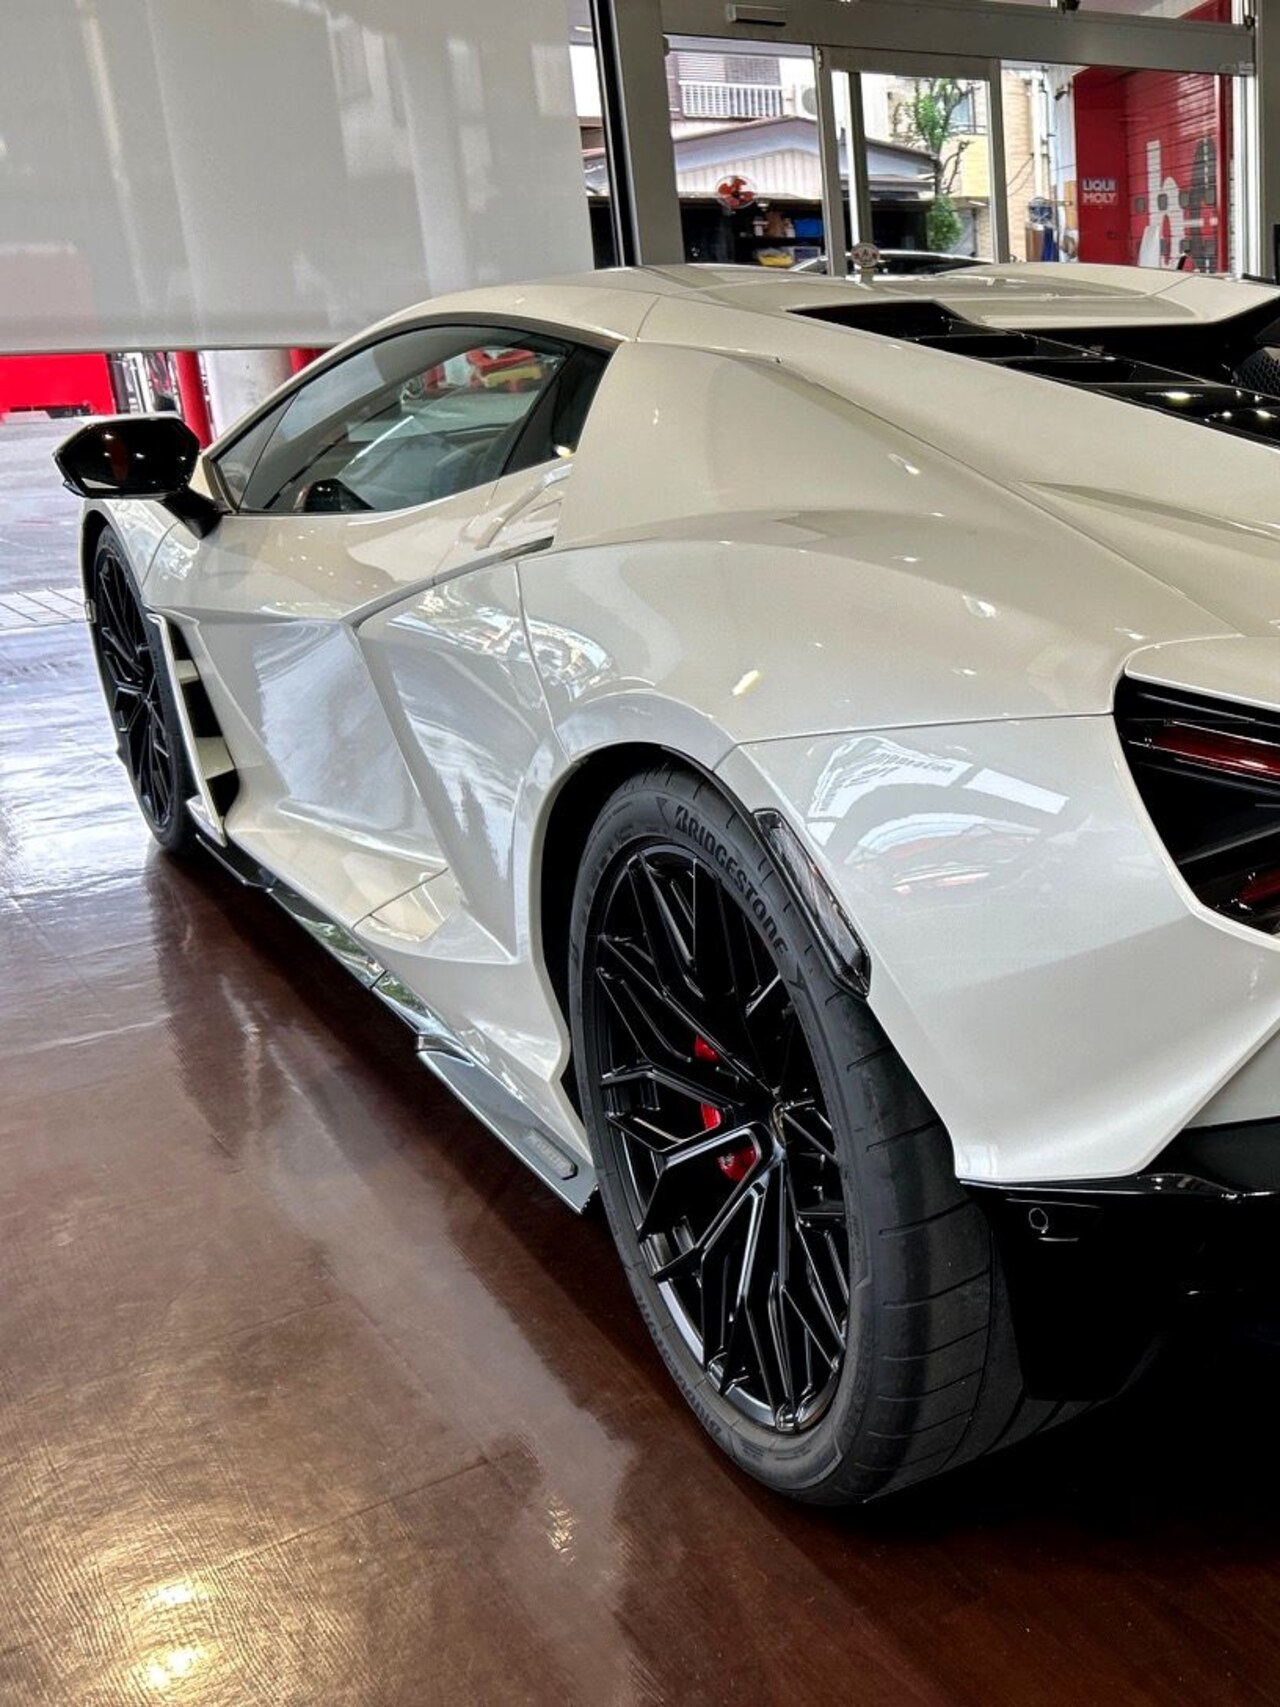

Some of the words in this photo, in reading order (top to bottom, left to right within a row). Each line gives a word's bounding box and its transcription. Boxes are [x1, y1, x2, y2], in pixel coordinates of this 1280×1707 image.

[1083, 179, 1116, 191] LIQUI
[1082, 192, 1117, 204] MOLY
[674, 804, 789, 955] BRIDGESTONE
